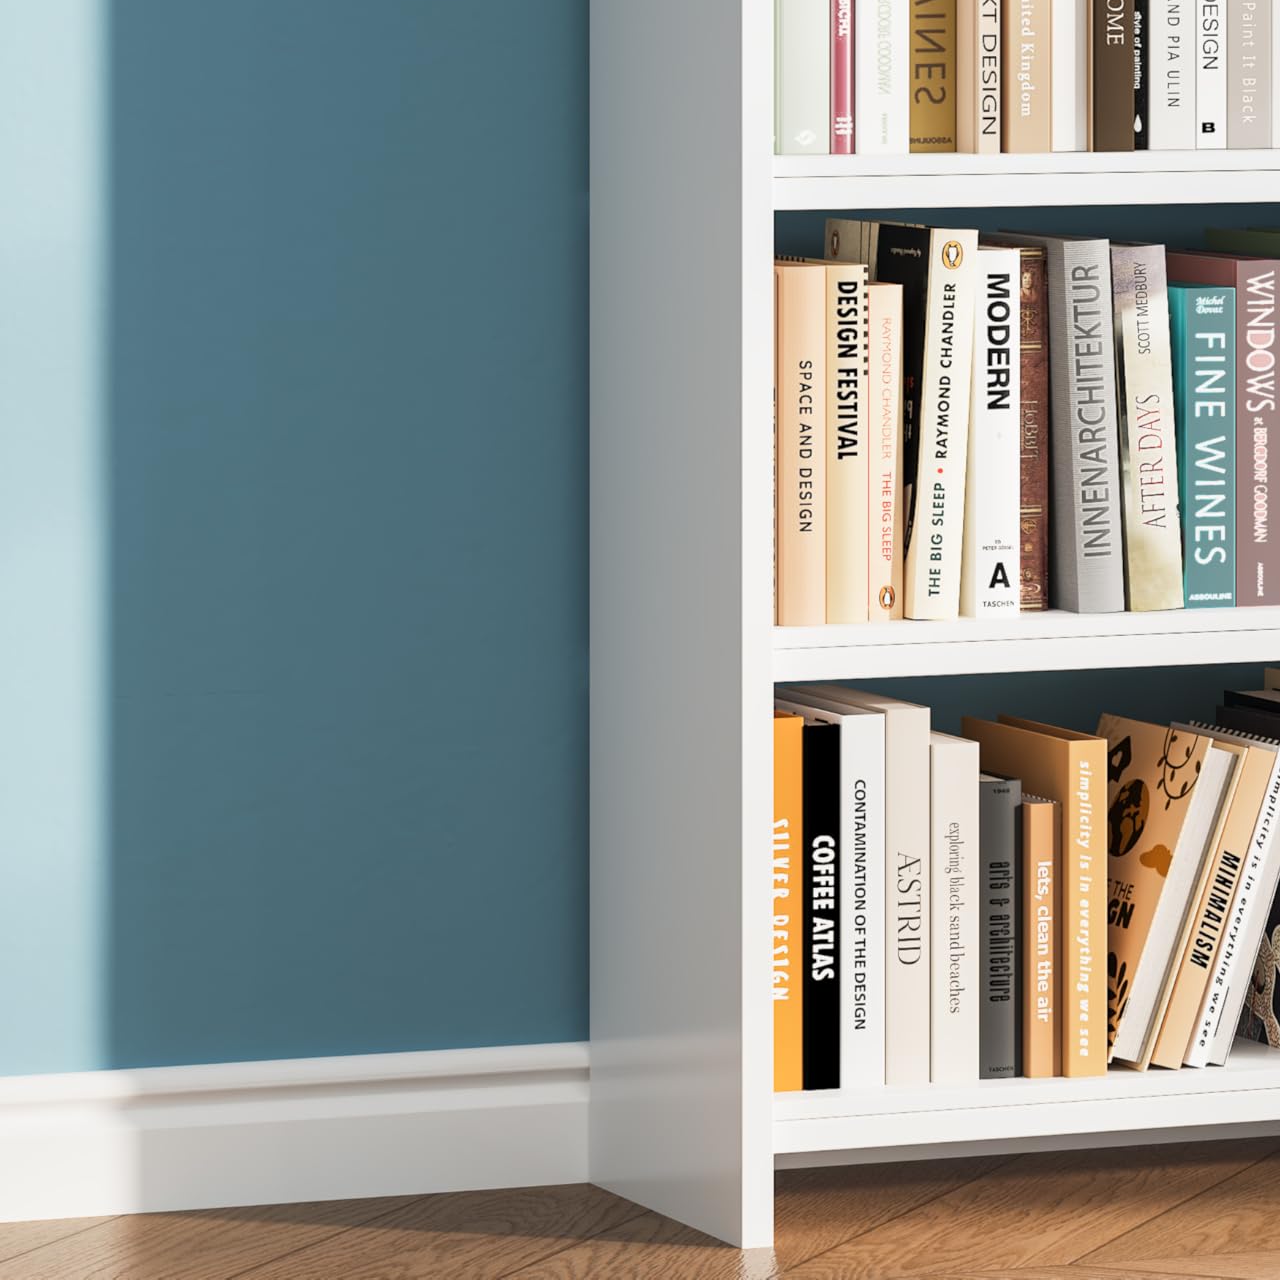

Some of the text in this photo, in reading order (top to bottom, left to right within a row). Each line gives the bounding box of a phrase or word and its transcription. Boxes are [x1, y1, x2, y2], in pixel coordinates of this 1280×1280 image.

[982, 34, 997, 135] DESIGN
[1018, 43, 1034, 116] Kingdom
[1167, 36, 1180, 60] PIA
[1167, 70, 1180, 107] ULIN
[837, 281, 857, 460] DESIGN FESTIVAL
[936, 283, 956, 458] RAYMOND CHANDLER
[987, 273, 1010, 410] MODERN
[1134, 263, 1151, 354] SCOTT MEDBURY
[799, 360, 811, 533] SPACE AND DESIGN
[1072, 265, 1111, 558] INNENARCHITEKTUR
[1136, 395, 1166, 528] AFTER DAYS
[1195, 333, 1226, 565] FINE WINES
[1246, 271, 1274, 542] WINDOWS at BERGDORF GOODMAN
[929, 483, 945, 596] THE BIG SLEEP
[813, 835, 834, 980] COFFEE ATLAS
[854, 780, 866, 1030] CONTAMINATION OF THE DESIGN
[945, 823, 965, 1013] exploring black sand beaches
[1035, 861, 1052, 1022] lets, clean the air
